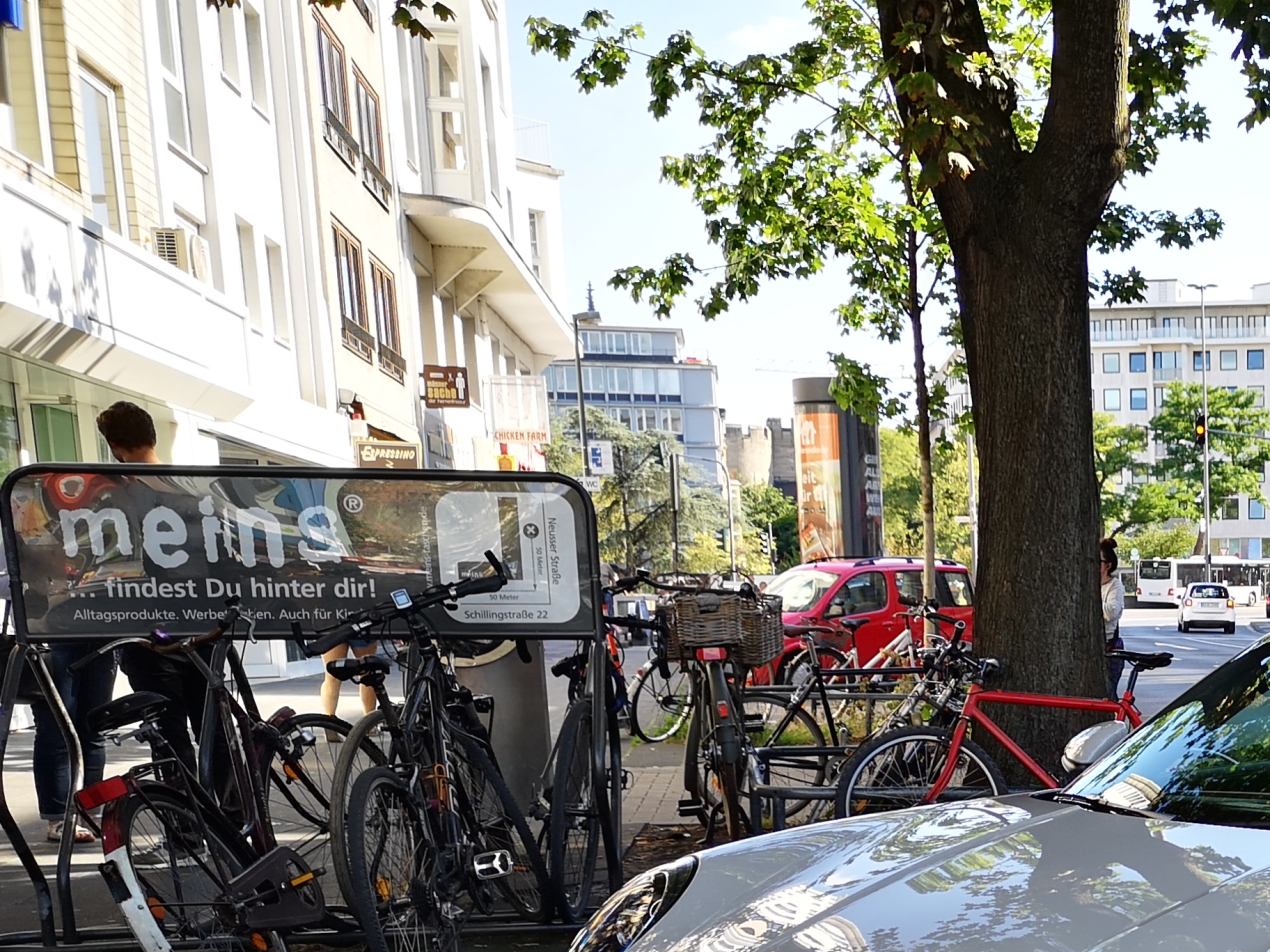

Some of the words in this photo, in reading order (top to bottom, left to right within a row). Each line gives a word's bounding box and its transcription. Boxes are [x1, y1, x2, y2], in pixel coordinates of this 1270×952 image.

[427, 387, 457, 399] sache
[494, 431, 525, 441] CHICKEN
[527, 431, 548, 441] FARM
[586, 480, 598, 488] WC
[58, 494, 343, 569] meins
[547, 517, 558, 554] Neusser
[536, 547, 543, 556] 50
[550, 555, 562, 586] Straße
[105, 576, 198, 598] findest
[205, 578, 242, 598] Du
[250, 576, 326, 598] hinter
[333, 576, 377, 598] dir!
[73, 608, 180, 623] Alltagsprodukte.
[279, 608, 310, 620] Auch
[313, 608, 333, 620] für
[464, 610, 534, 620] Schillingstraße
[536, 610, 549, 620] 22
